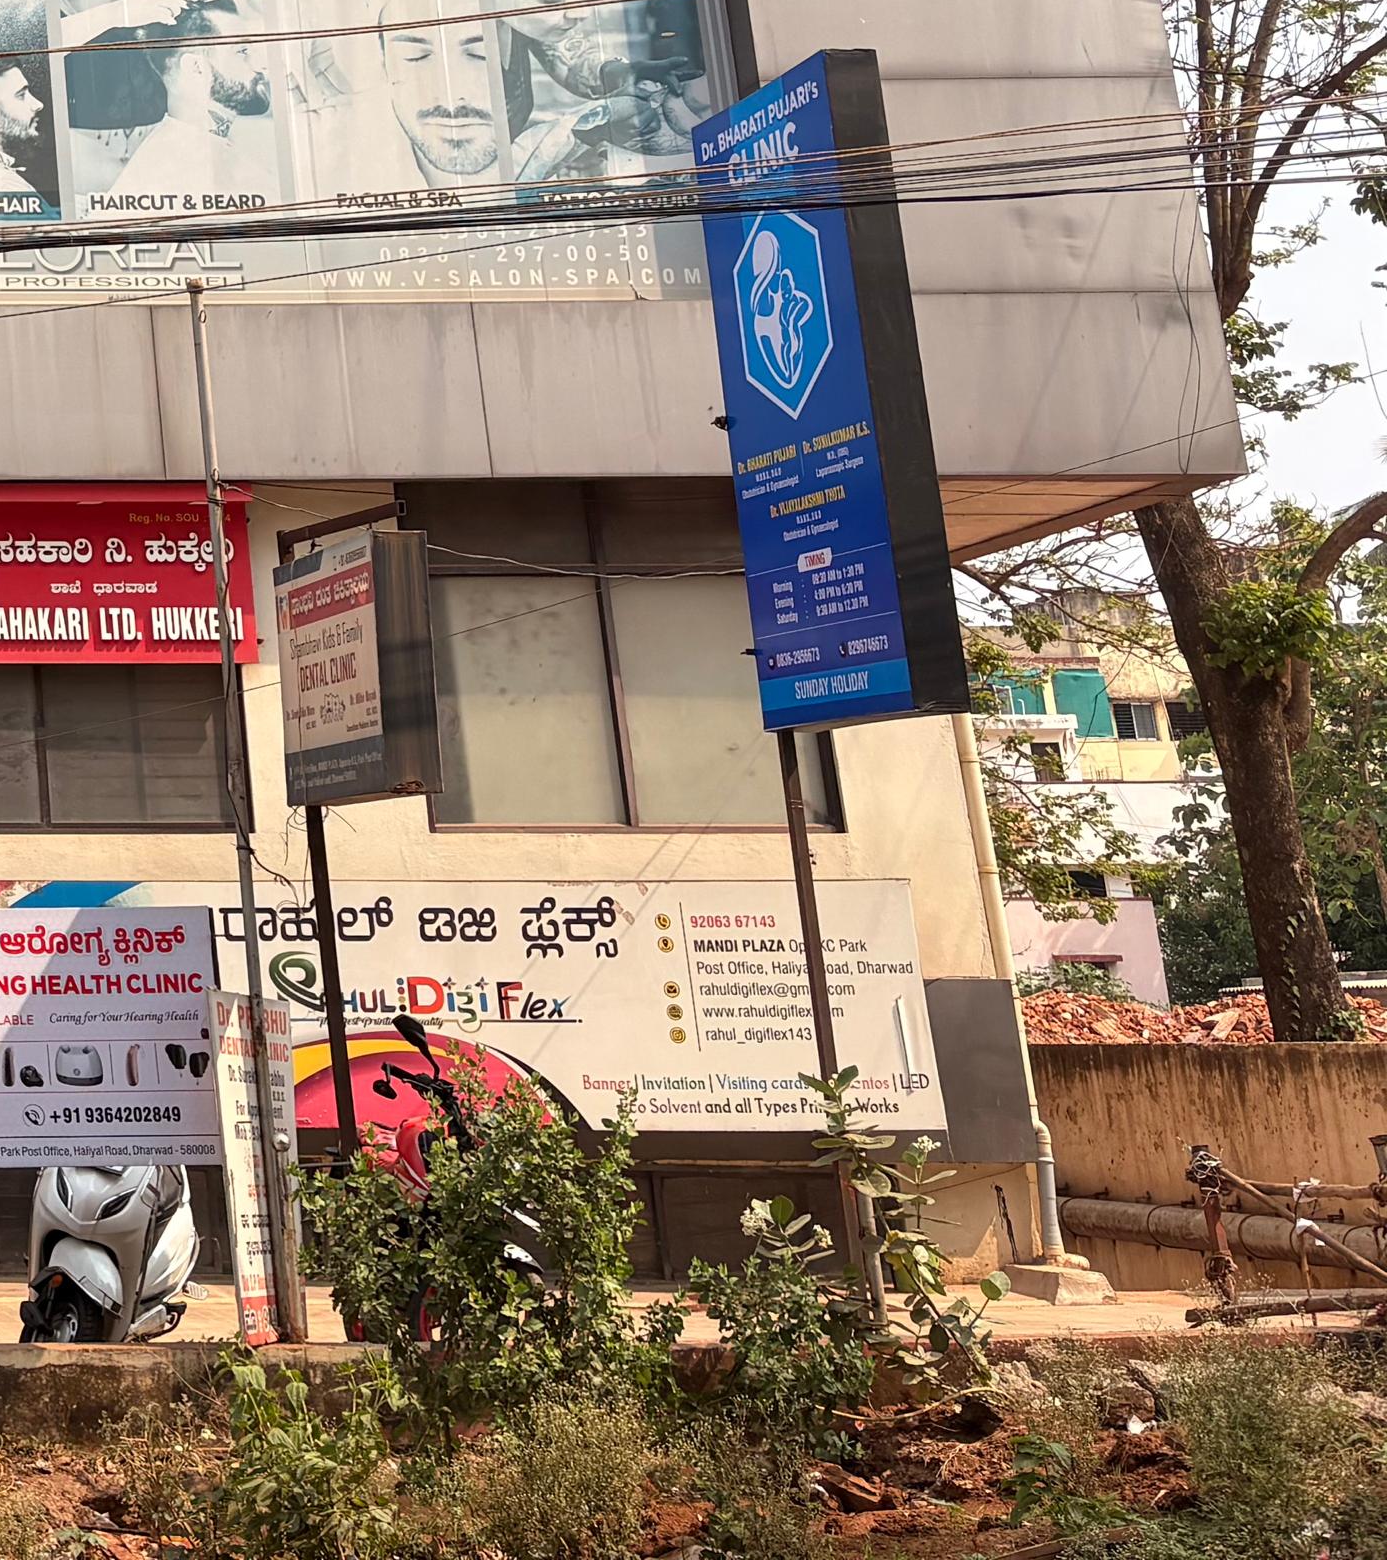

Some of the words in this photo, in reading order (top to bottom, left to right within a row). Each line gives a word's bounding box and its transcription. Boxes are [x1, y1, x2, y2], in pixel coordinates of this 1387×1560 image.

[700, 138, 718, 162] Dr.
[718, 107, 768, 154] BHARATI
[767, 81, 819, 126] PUJARI's
[727, 121, 799, 188] CLINIC
[90, 194, 178, 211] HAIRCUT
[182, 194, 198, 210] &
[203, 193, 266, 210] BEARD
[100, 607, 143, 640] LTD.
[300, 659, 329, 692] DENTAL
[330, 652, 356, 684] CLINIC
[794, 676, 829, 700] SUNDAY
[831, 670, 869, 696] HOLIDAY
[690, 915, 731, 928] 92063
[735, 915, 776, 928] 67143
[112, 925, 186, 967] ಕ್ಲಿನಿಕ್
[694, 940, 738, 952] MANDI
[743, 940, 785, 952] PLAZA
[839, 939, 867, 952] Park
[697, 962, 724, 975] Post
[728, 961, 768, 976] Office,
[858, 961, 913, 974] Dharwad
[31, 975, 121, 995] HEALTH
[127, 973, 204, 994] CLINIC
[642, 1074, 706, 1090] Invitation
[716, 1074, 767, 1093] Visiting
[50, 1107, 80, 1123] +91
[86, 1106, 181, 1123] 9364202849
[649, 1099, 702, 1114] Solvent
[705, 1099, 731, 1113] and
[754, 1098, 797, 1116] Types
[859, 1099, 899, 1114] Works
[132, 1145, 173, 1155] Dharwad
[180, 1145, 215, 1155] 580008
